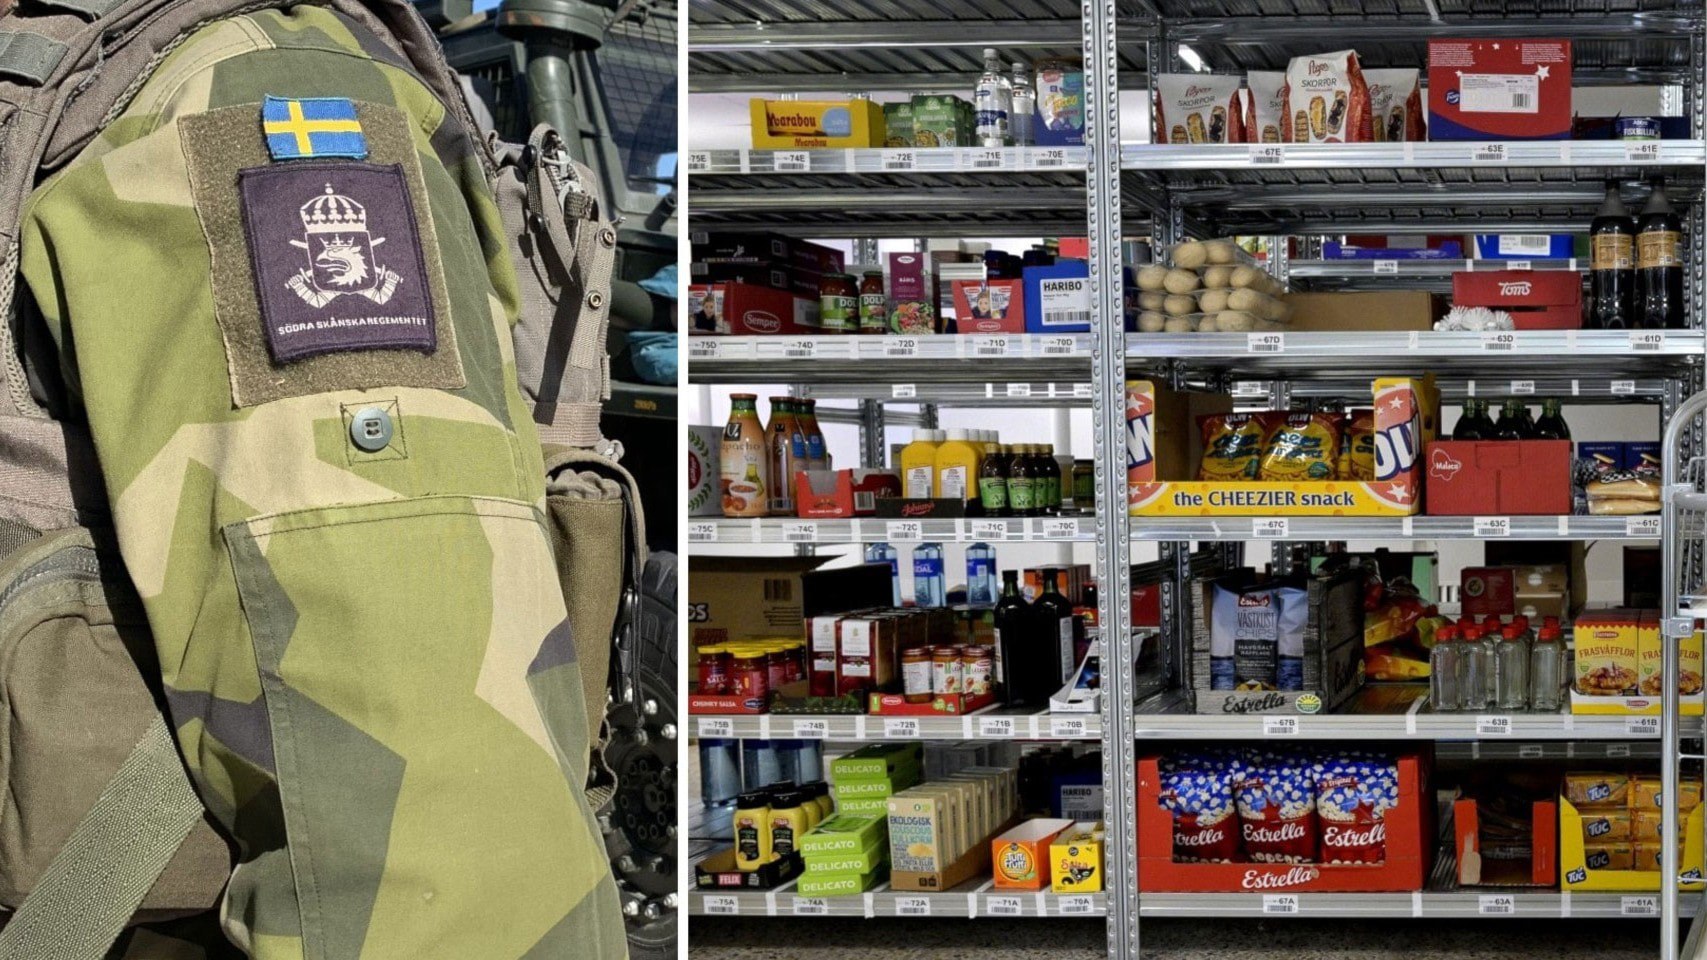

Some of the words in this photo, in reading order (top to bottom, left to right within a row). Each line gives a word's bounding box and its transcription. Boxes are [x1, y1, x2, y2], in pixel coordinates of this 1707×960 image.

[1301, 78, 1337, 88] SKORPOR
[1178, 95, 1216, 107] SKORPOR
[768, 112, 816, 127] Marabou
[794, 138, 827, 147] Marabou
[1265, 148, 1281, 156] 67E
[1487, 144, 1503, 152] 63E
[1641, 144, 1657, 152] 61E
[790, 154, 805, 162] 74E
[897, 153, 912, 161] 72E
[985, 151, 1000, 159] 71E
[1043, 281, 1082, 291] HARIBO
[1498, 281, 1532, 296] Toms
[278, 322, 315, 335] SÖDRA
[316, 317, 366, 329] SKÅNSKA
[367, 316, 427, 326] REGEMENTET
[747, 314, 778, 329] Semper
[700, 341, 716, 349] 75D
[797, 341, 813, 349] 74D
[989, 339, 1005, 347] 71D
[1056, 338, 1072, 346] 70D
[1174, 490, 1203, 506] the
[1207, 491, 1297, 506] CHEEZIER
[1301, 490, 1354, 506] snack
[902, 523, 918, 531] 72C
[987, 523, 1003, 531] 71C
[1059, 522, 1075, 530] 70C
[1490, 519, 1506, 527] 63C
[1642, 519, 1658, 527] 61C
[798, 525, 813, 533] 74C
[1237, 609, 1275, 628] VÄSTKUST
[1236, 628, 1277, 638] CHIPS
[1578, 644, 1636, 658] FRASVÅFFLOR
[1222, 693, 1286, 713] Estrella
[995, 720, 1010, 728] 71B
[1492, 718, 1508, 726] 63B
[835, 765, 881, 774] DELICATO
[839, 784, 886, 793] DELICATO
[890, 816, 932, 825] EKOLOGISK
[1243, 822, 1305, 842] Estrella
[804, 840, 855, 851] DELICATO
[810, 861, 862, 871] DELICATO
[718, 873, 741, 885] FELIX
[1241, 867, 1313, 889] Estrella
[803, 880, 855, 891] DELICATO
